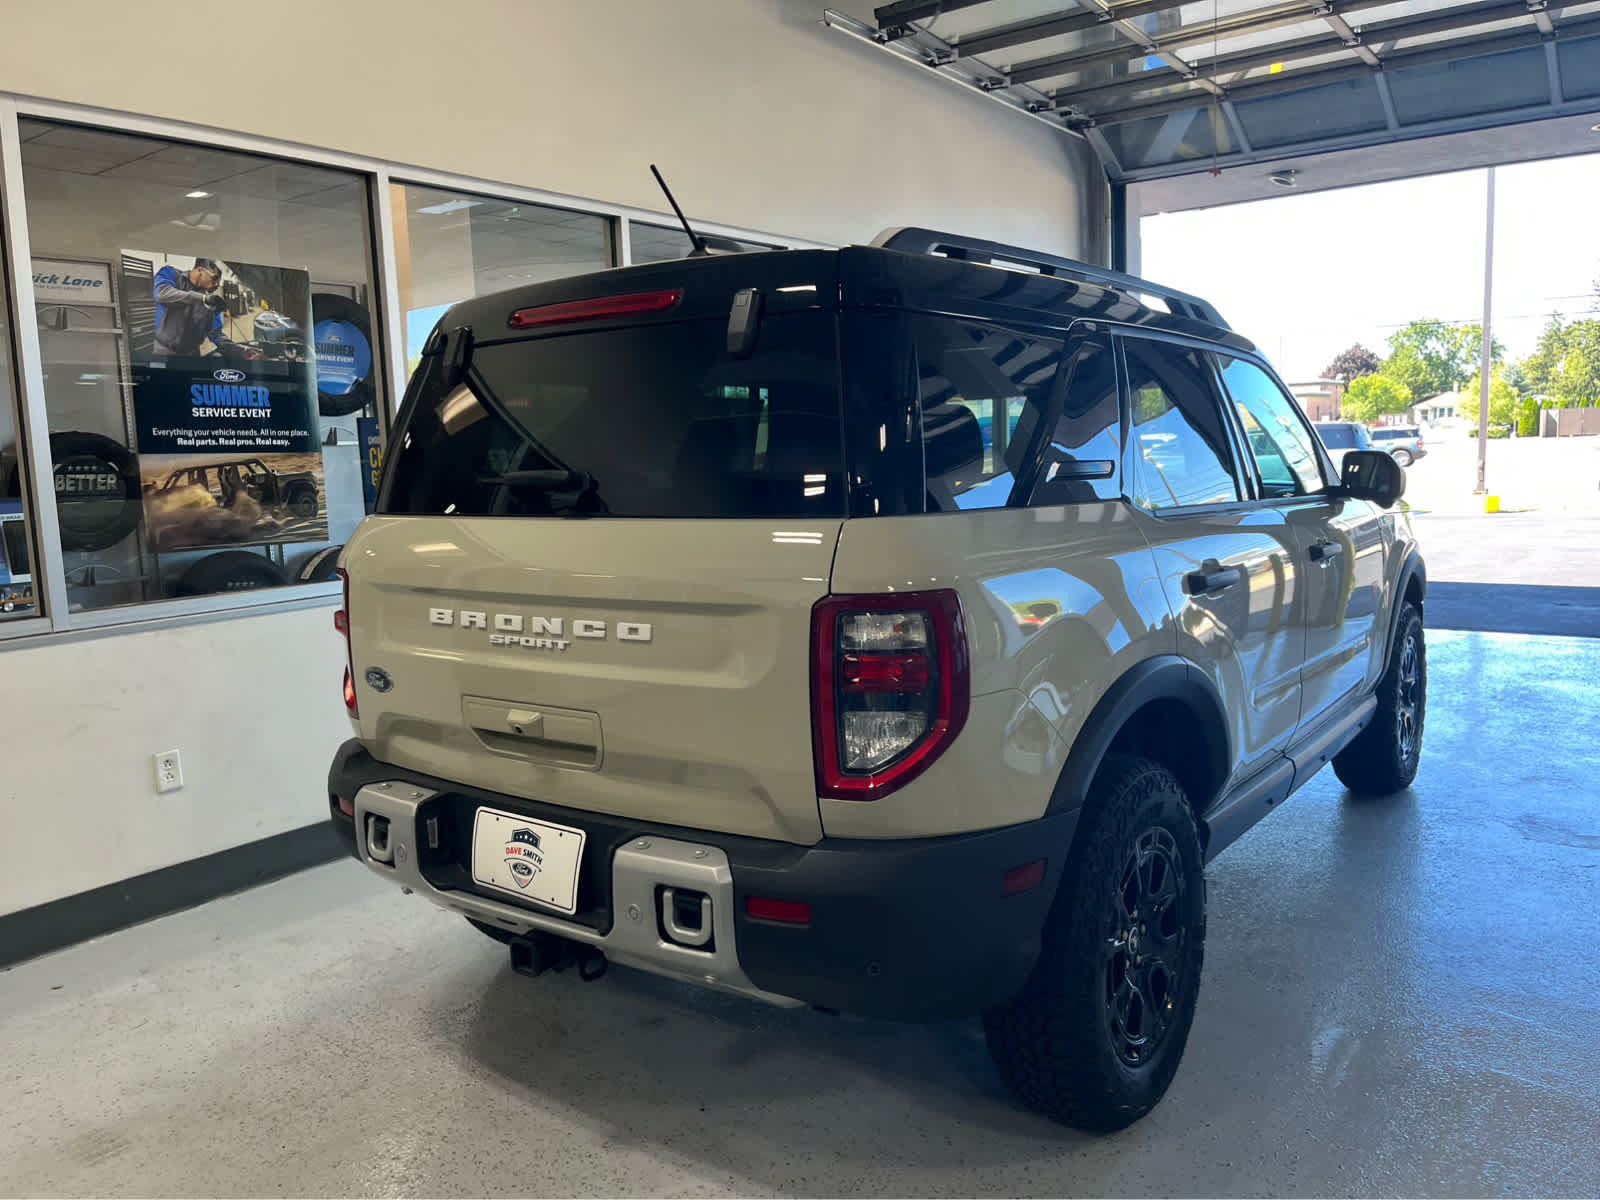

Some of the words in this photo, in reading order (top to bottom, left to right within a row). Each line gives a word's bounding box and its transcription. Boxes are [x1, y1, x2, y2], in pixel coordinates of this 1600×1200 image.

[32, 272, 60, 284] uick
[62, 274, 104, 288] Lane
[190, 383, 271, 407] SUMMER
[191, 407, 238, 418] SERVICE
[239, 408, 272, 418] EVENT
[151, 427, 193, 437] Everything
[193, 429, 210, 437] your
[210, 427, 236, 437] vehicle
[236, 428, 260, 437] needs.
[260, 428, 269, 436] All
[269, 428, 277, 436] in
[277, 429, 290, 437] one
[290, 428, 310, 438] place.
[177, 437, 195, 446] Real
[195, 438, 218, 447] parts.
[218, 437, 236, 446] Real
[236, 438, 256, 447] pros.
[255, 437, 272, 446] Real
[272, 438, 291, 447] easy.
[55, 473, 118, 491] BETTER
[429, 607, 652, 641] BRONCO
[488, 634, 572, 650] SPORT
[505, 846, 522, 856] DAVE
[522, 848, 543, 865] SMITH
